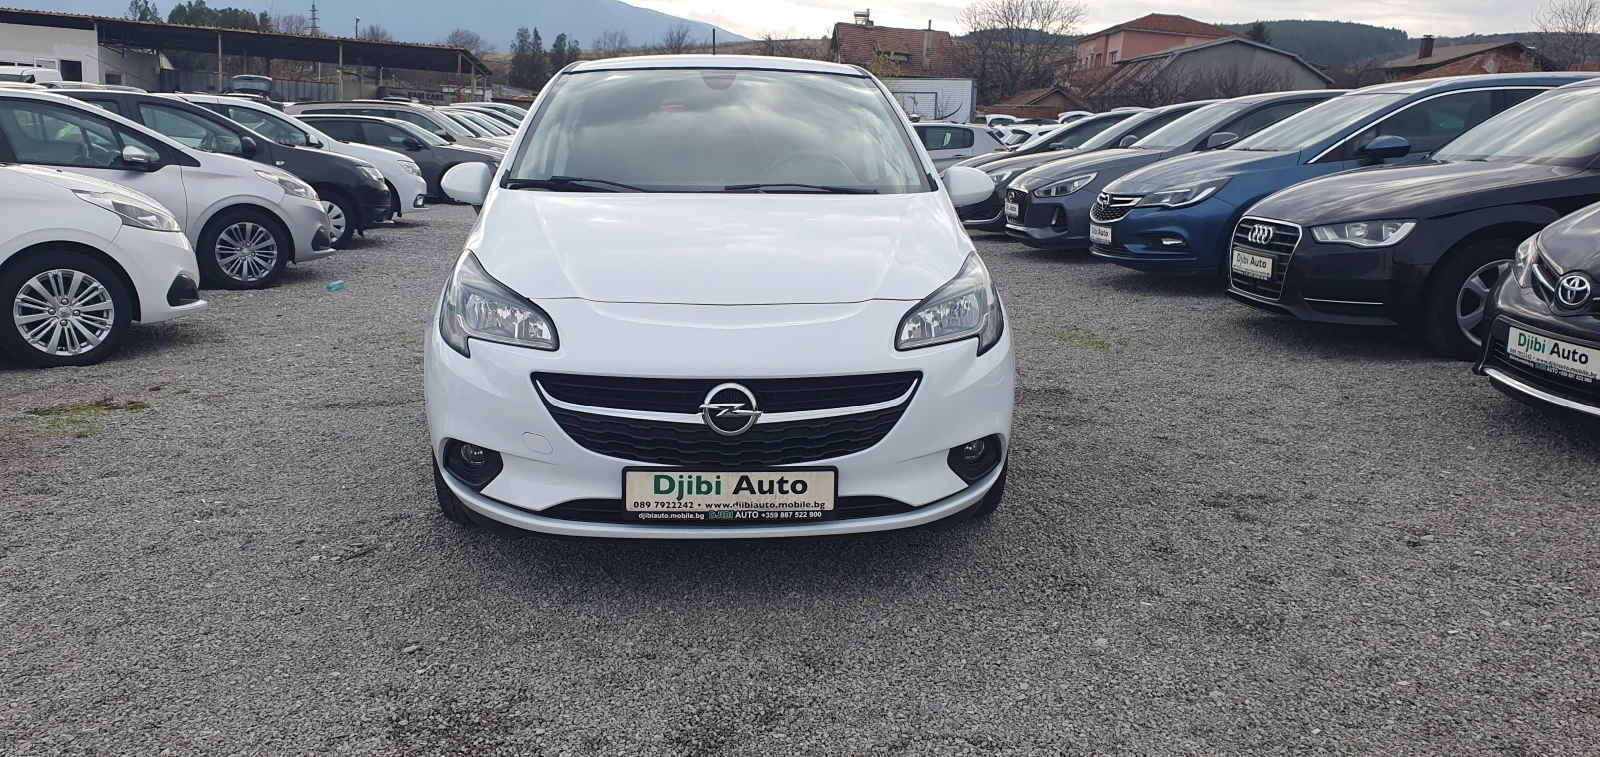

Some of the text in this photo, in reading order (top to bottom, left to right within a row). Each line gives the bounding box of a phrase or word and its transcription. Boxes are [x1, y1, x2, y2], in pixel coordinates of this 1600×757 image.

[1250, 256, 1267, 269] Auto
[1518, 332, 1546, 354] Djibi
[1549, 342, 1589, 365] Auto
[653, 474, 808, 502] Djibi Auto
[633, 501, 651, 509] 089
[654, 501, 694, 509] 7922242
[709, 511, 734, 519] DJIBI
[735, 511, 759, 519] AUTO
